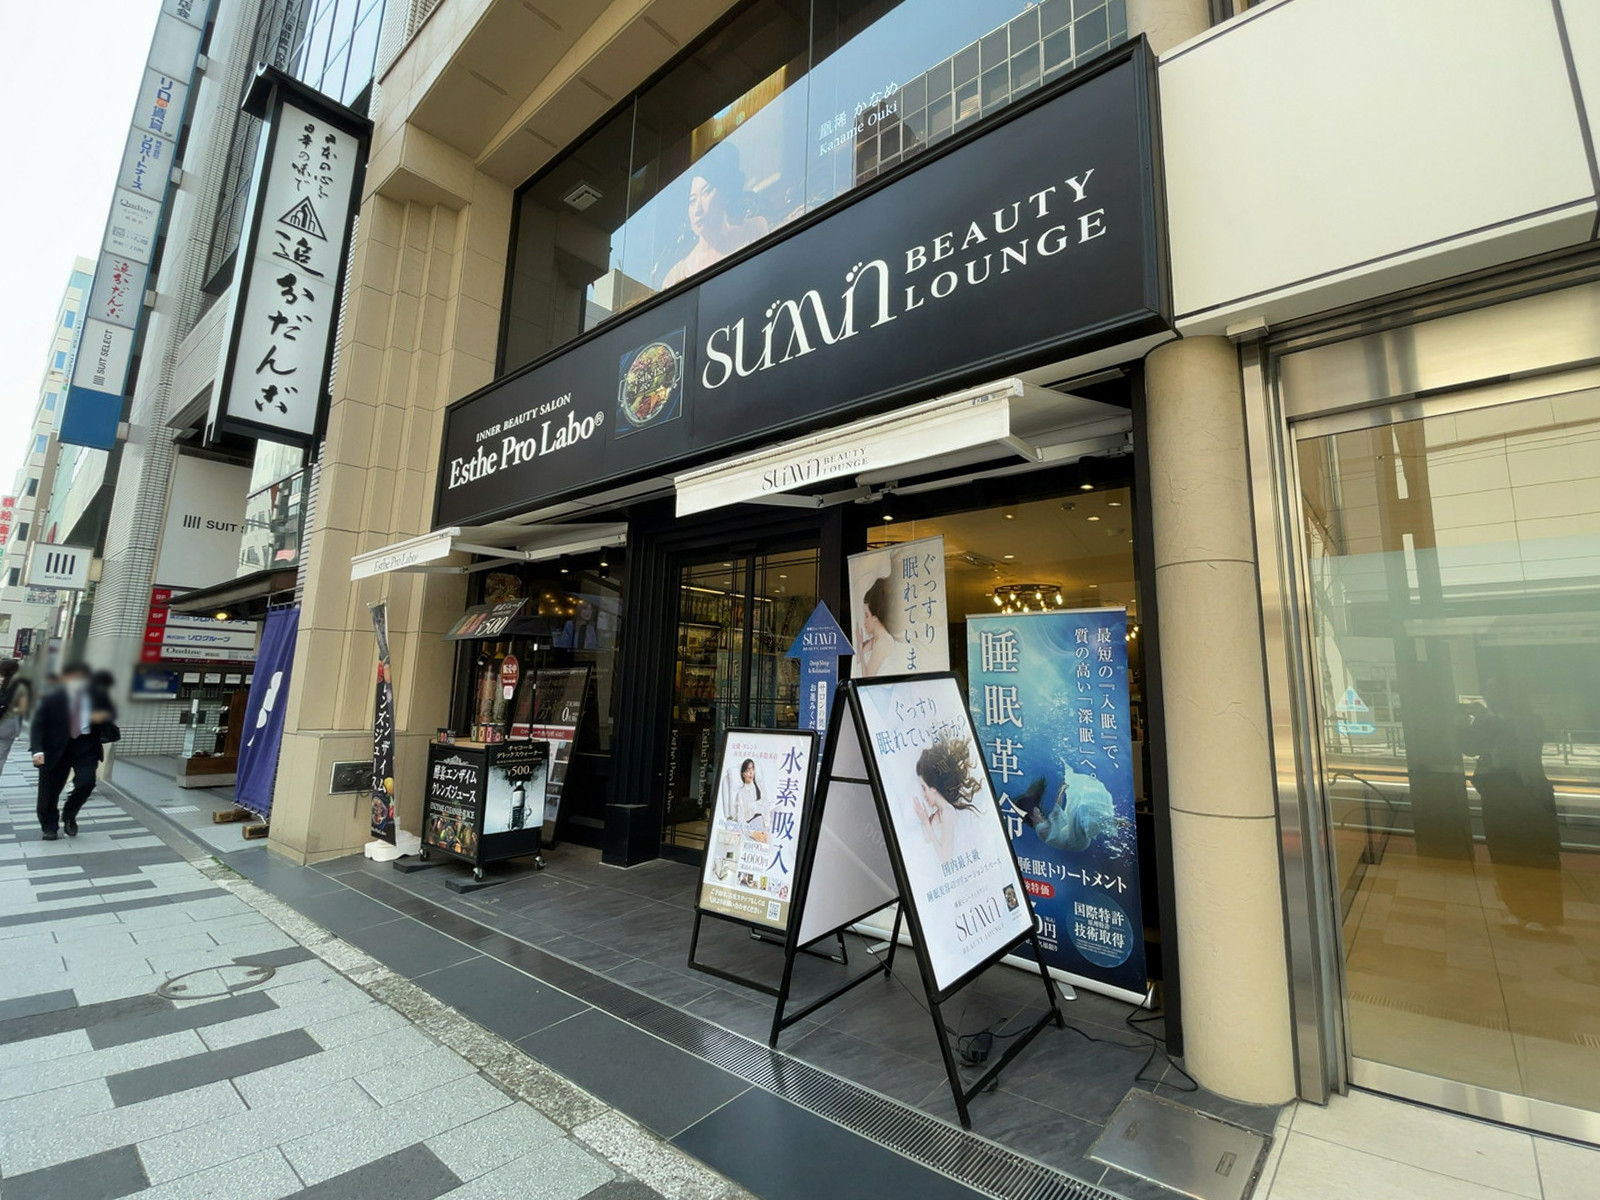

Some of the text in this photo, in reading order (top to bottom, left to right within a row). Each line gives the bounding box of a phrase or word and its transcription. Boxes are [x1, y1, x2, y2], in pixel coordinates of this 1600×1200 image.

[854, 81, 898, 118] かなめ
[819, 100, 898, 156] Kaname Ouki
[904, 168, 1096, 275] BEAUTY
[904, 208, 1107, 312] LOUNGE
[255, 230, 324, 414] 追分だんご
[97, 329, 113, 375] SUIT SELECT
[475, 392, 571, 442] INNER BEAUTY SALON
[448, 445, 498, 489] Esthe
[500, 436, 536, 470] Pro
[823, 457, 869, 475] LOUNGE
[824, 447, 868, 465] BEAUTY
[206, 520, 238, 532] SUIT
[902, 556, 918, 670] 眠れていま
[922, 553, 936, 645] ぐっすり
[188, 634, 230, 642] リログループ
[895, 697, 937, 721] ぐっすり
[1075, 628, 1097, 781] 質の高い「深眠」へ。
[980, 630, 1028, 841] 睡眠革命
[431, 782, 476, 803] クレンズジュース
[766, 746, 803, 875] 水素吸入
[941, 848, 980, 877] 国内最大級
[1074, 901, 1125, 927] 国際特許
[1074, 921, 1126, 948] 技術取得
